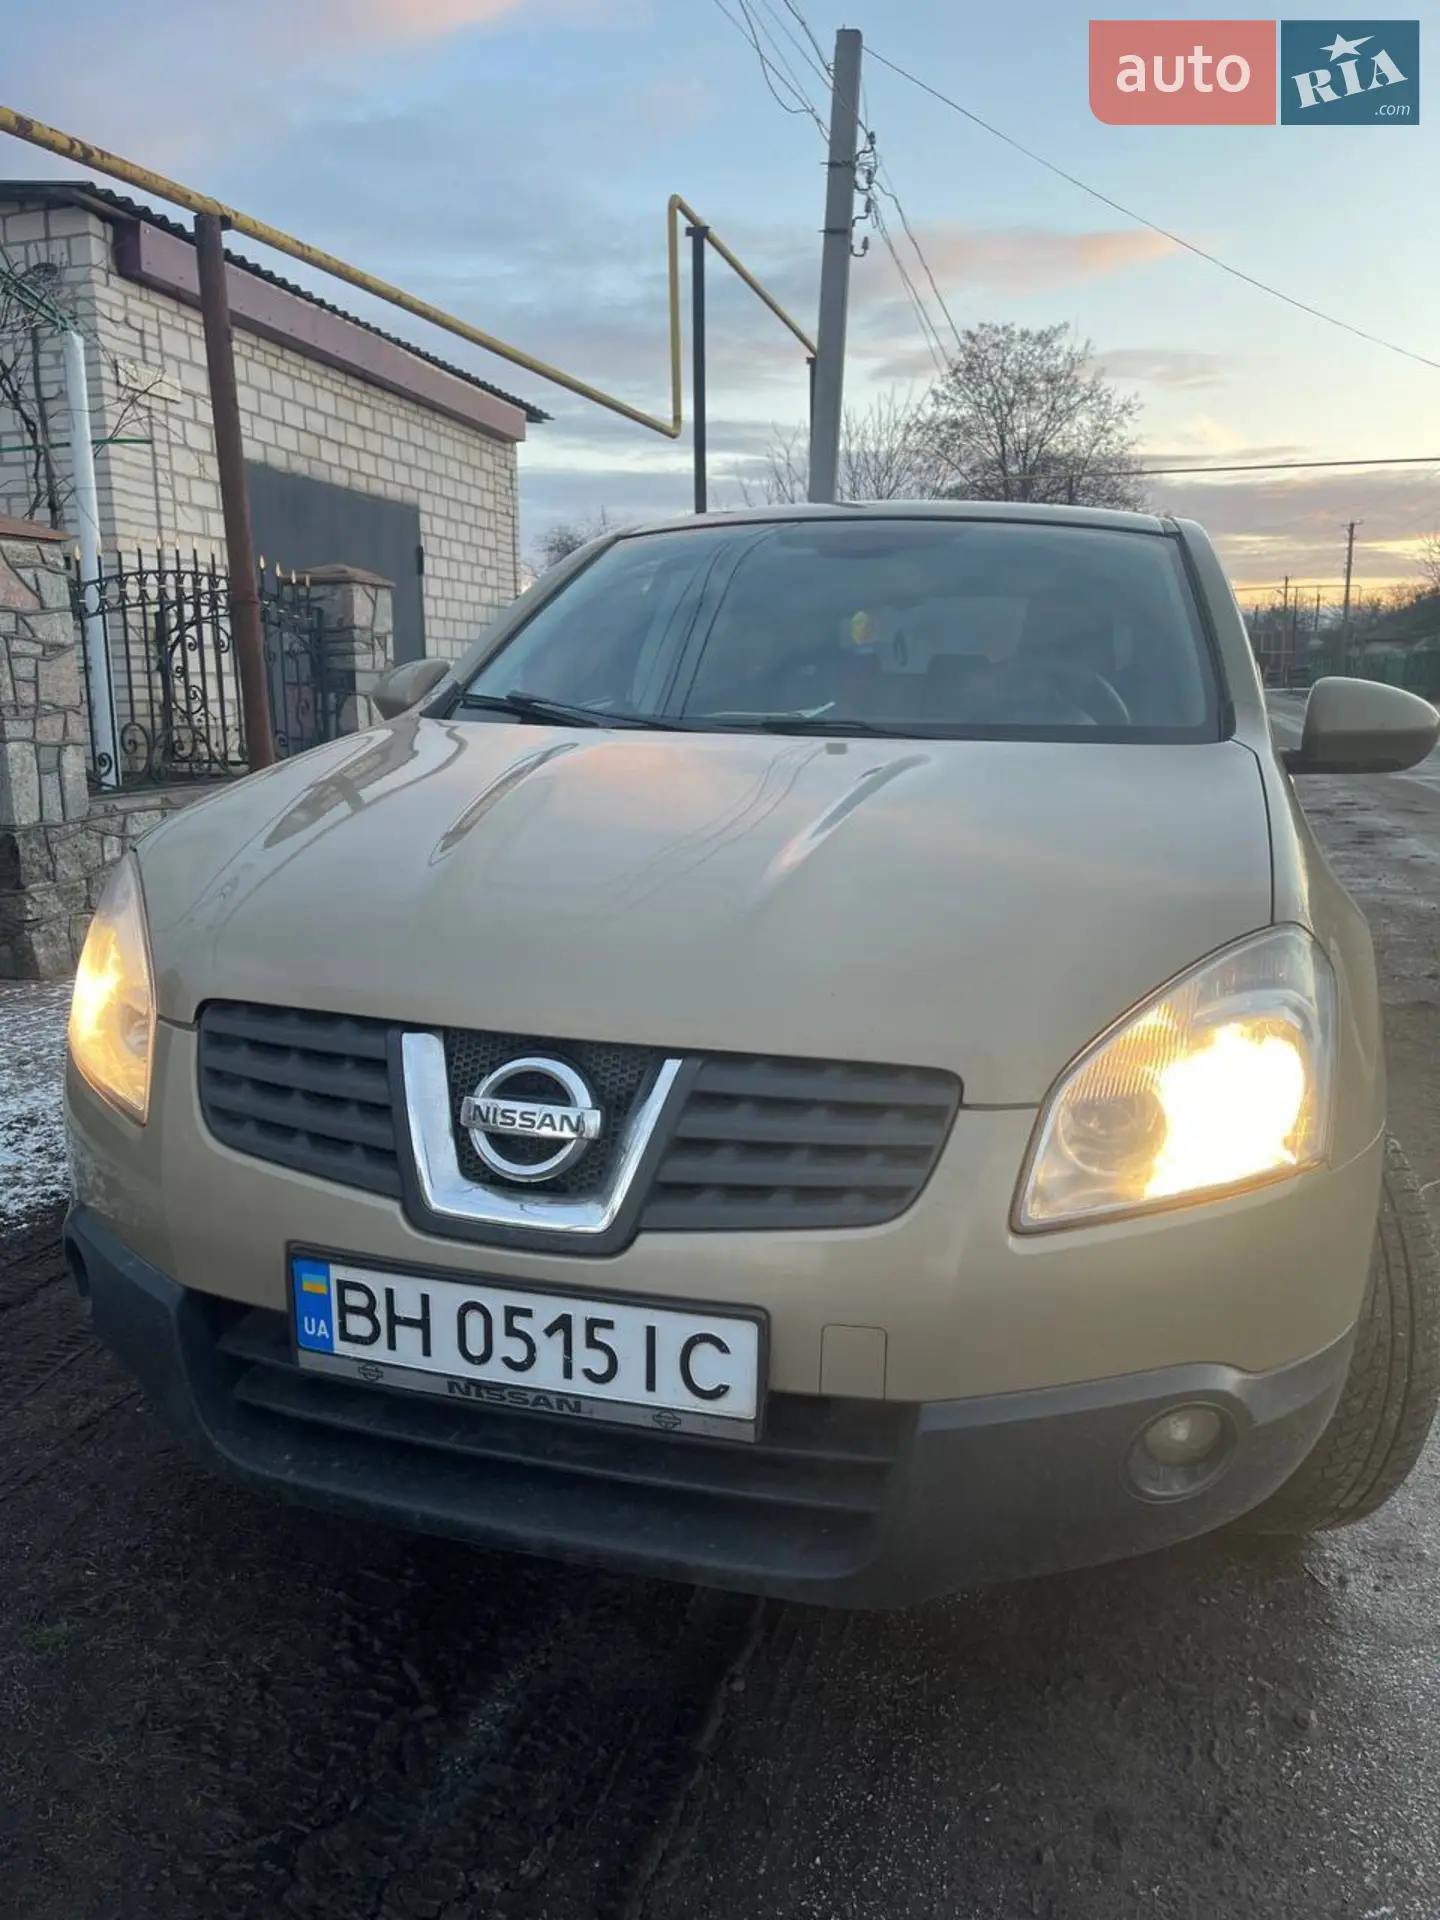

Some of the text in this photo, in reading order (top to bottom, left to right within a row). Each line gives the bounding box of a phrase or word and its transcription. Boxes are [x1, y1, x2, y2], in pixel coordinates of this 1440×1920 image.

[472, 1103, 585, 1133] NISSAN
[304, 1316, 329, 1339] UA
[336, 1278, 731, 1400] BH 0515 IC
[447, 1379, 583, 1414] NISSAN
